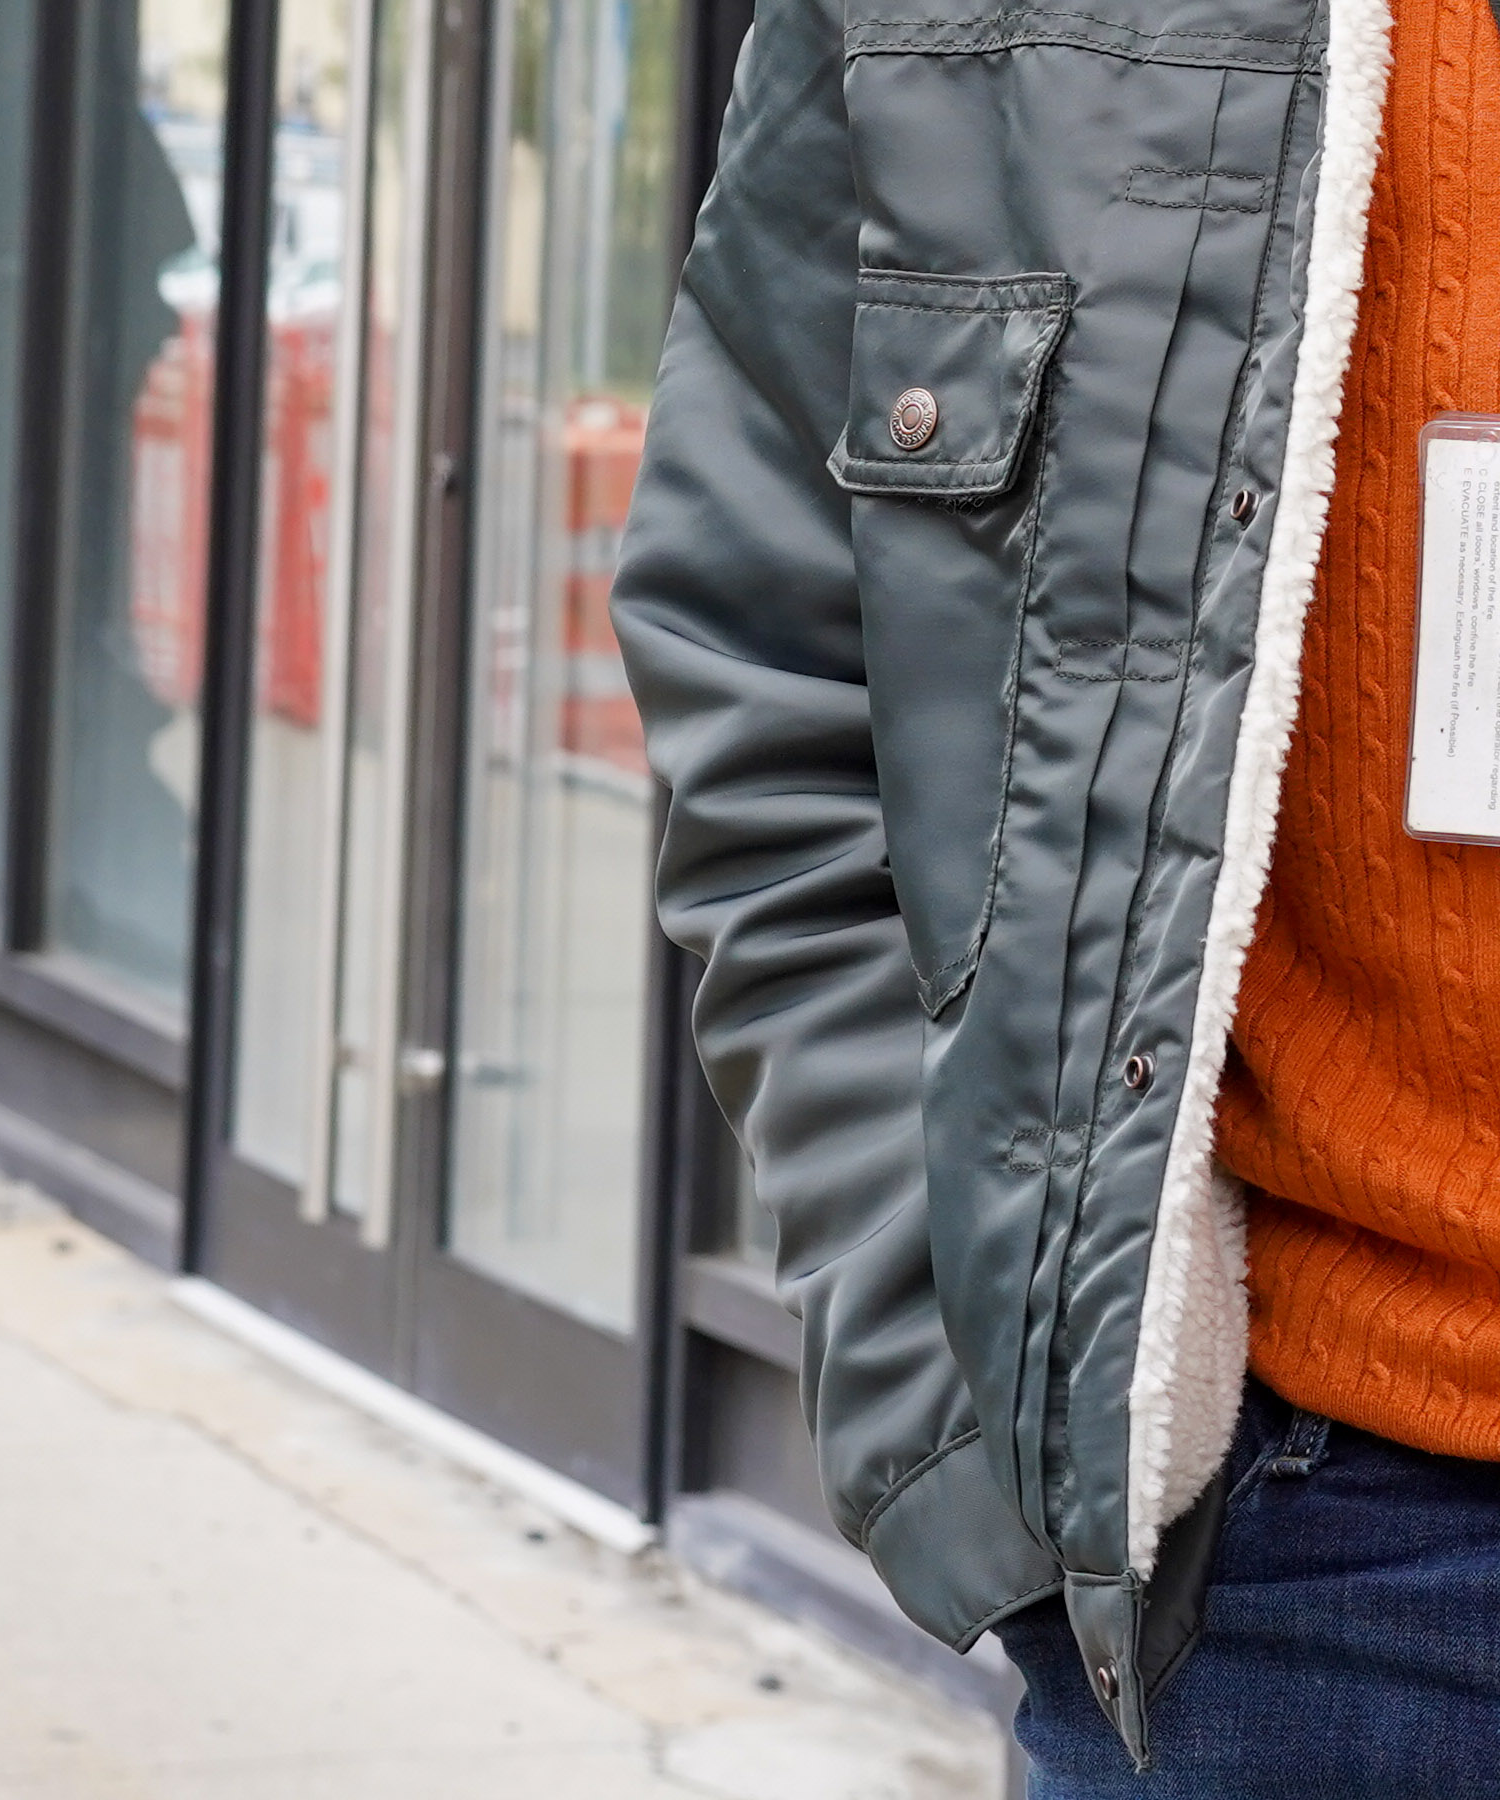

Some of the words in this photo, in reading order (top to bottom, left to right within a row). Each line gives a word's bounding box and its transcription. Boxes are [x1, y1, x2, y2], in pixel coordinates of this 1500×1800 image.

[1476, 482, 1487, 518] CLOSE
[1492, 481, 1500, 510] extent
[1460, 481, 1472, 539] EVACUATE
[1475, 521, 1484, 532] all
[1491, 512, 1500, 531] and
[1459, 542, 1466, 553] as
[1489, 534, 1499, 572] location
[1488, 574, 1497, 585] of
[1487, 587, 1496, 602] the
[1453, 611, 1465, 661] Extinguish
[1469, 615, 1479, 651] confine
[1468, 654, 1477, 669] the
[1452, 664, 1461, 679] the
[1467, 672, 1476, 687] fire
[1451, 682, 1460, 697] fire
[1450, 700, 1459, 710] (if
[1487, 764, 1499, 810] regarding
